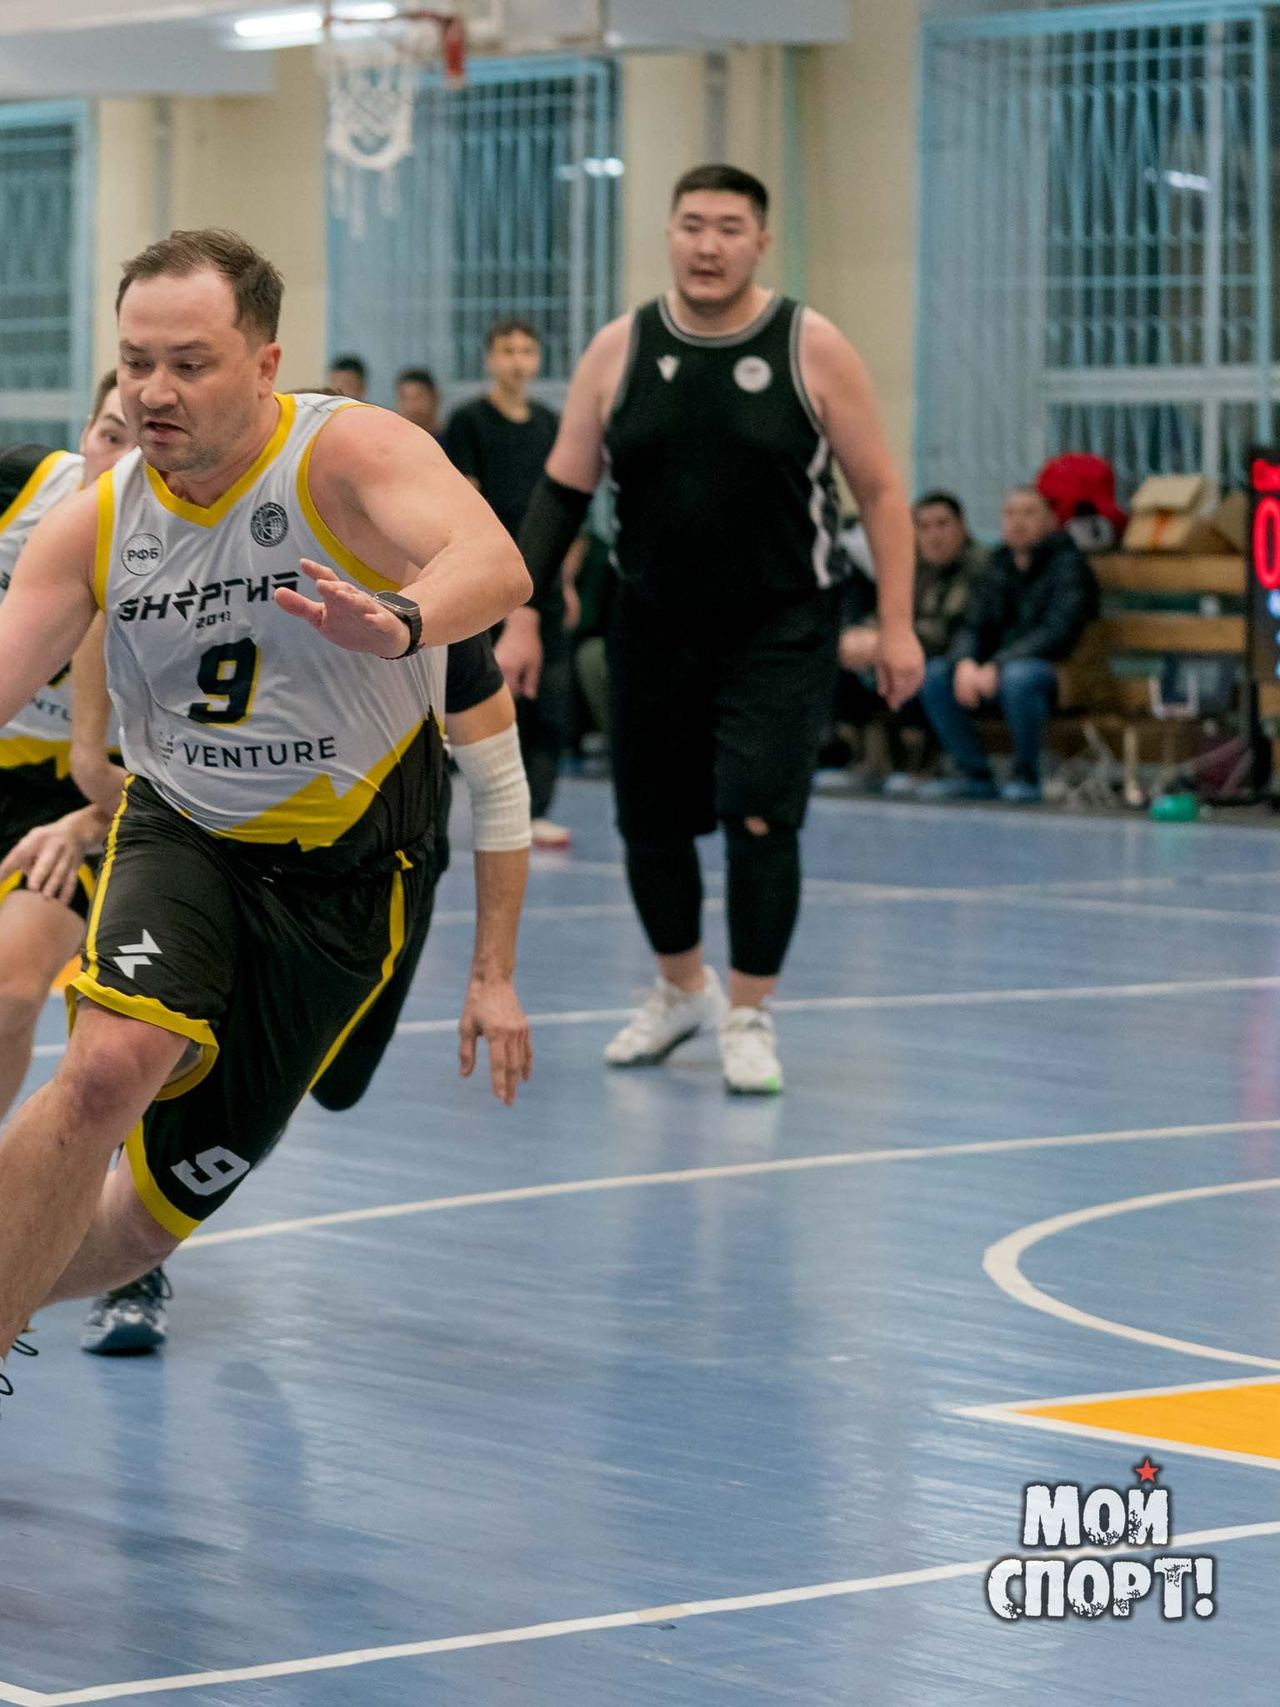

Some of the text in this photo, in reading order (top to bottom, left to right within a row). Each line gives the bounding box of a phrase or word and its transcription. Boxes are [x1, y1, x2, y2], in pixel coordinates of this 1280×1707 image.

[127, 547, 160, 561] РФБ
[187, 637, 260, 726] 9
[183, 736, 337, 768] VENTURE
[171, 1146, 250, 1196] 9
